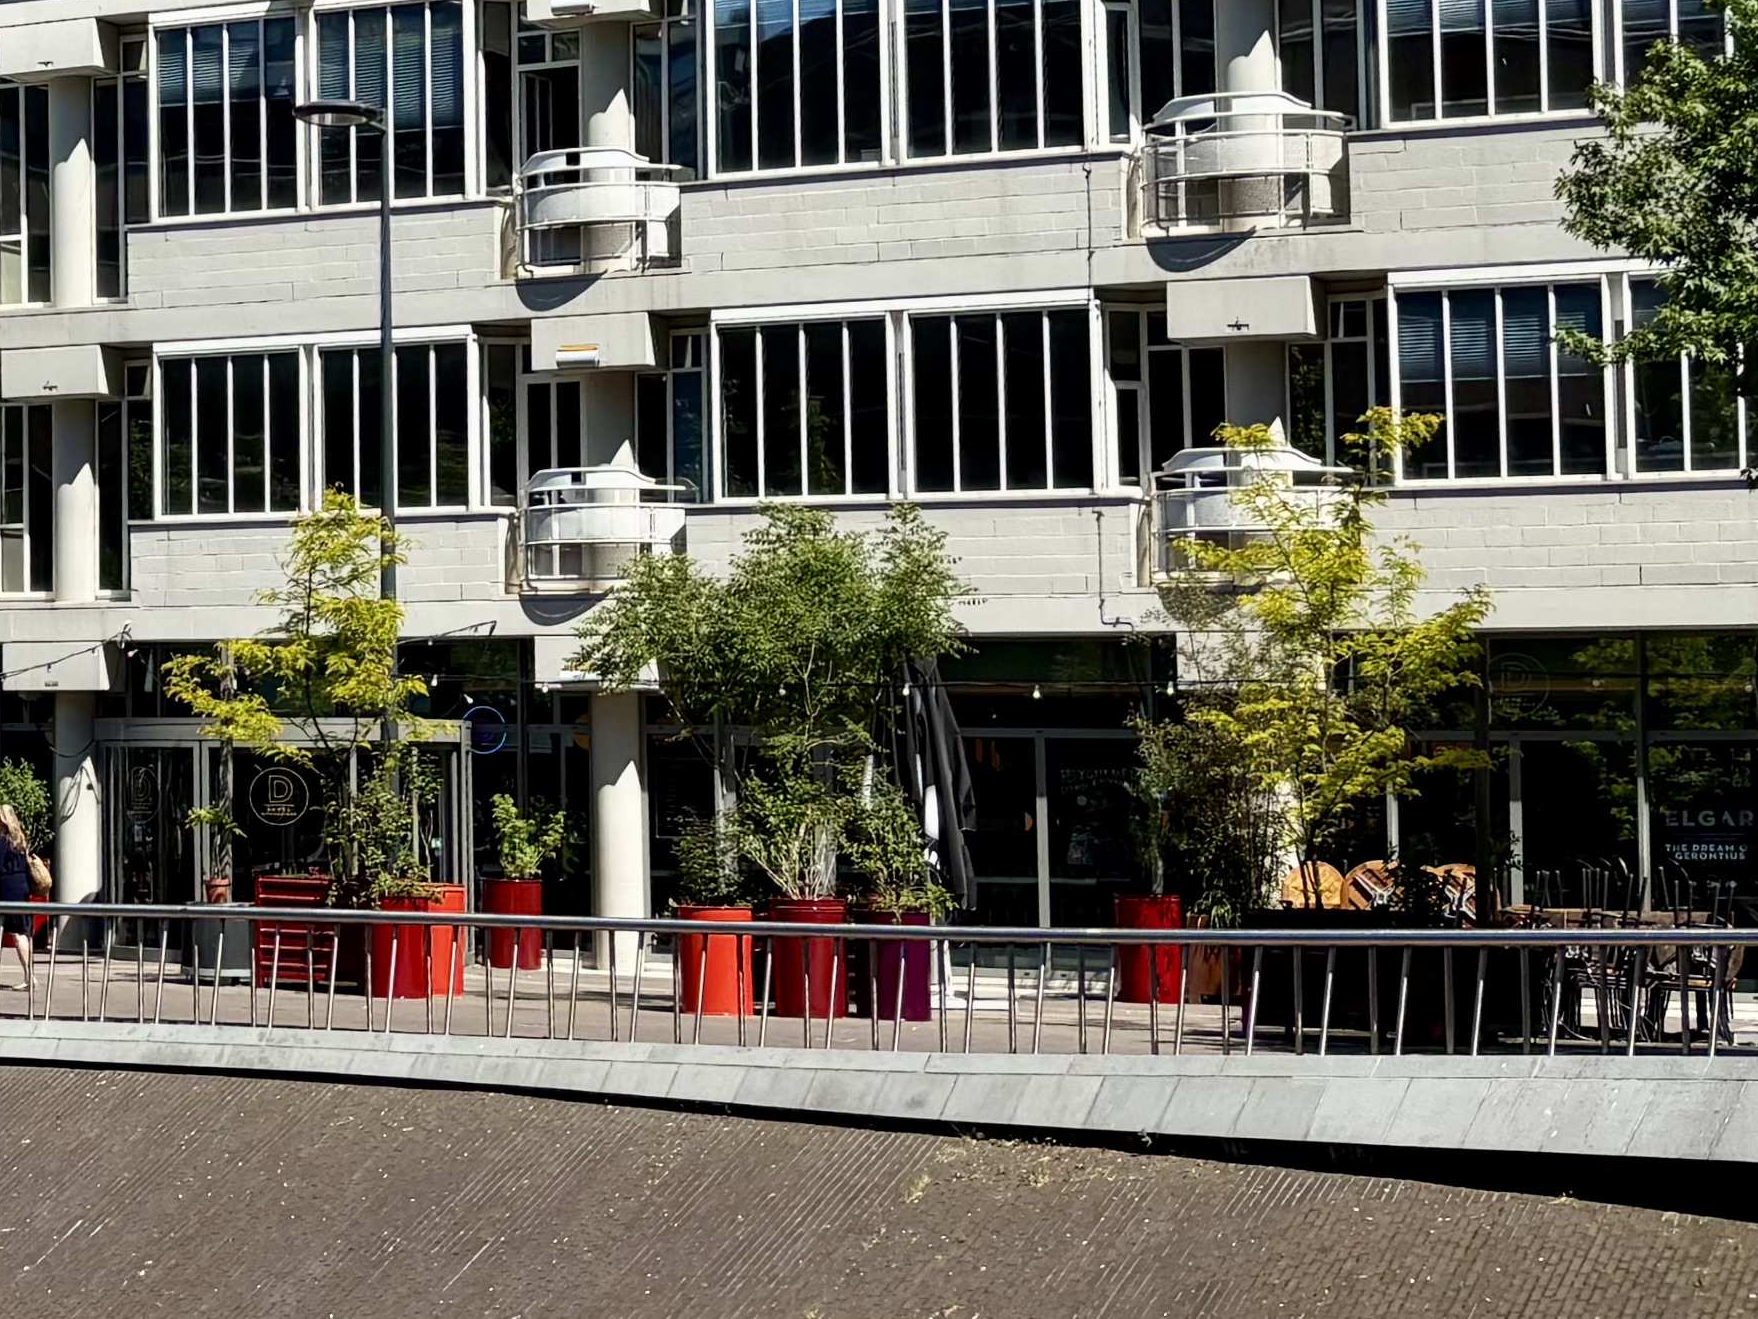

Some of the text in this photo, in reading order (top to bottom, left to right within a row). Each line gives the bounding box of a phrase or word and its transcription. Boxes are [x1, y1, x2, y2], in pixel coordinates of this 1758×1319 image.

[1665, 810, 1755, 827] ELGAR
[1692, 844, 1735, 852] DREAM
[1674, 852, 1746, 861] GERONTIUS
